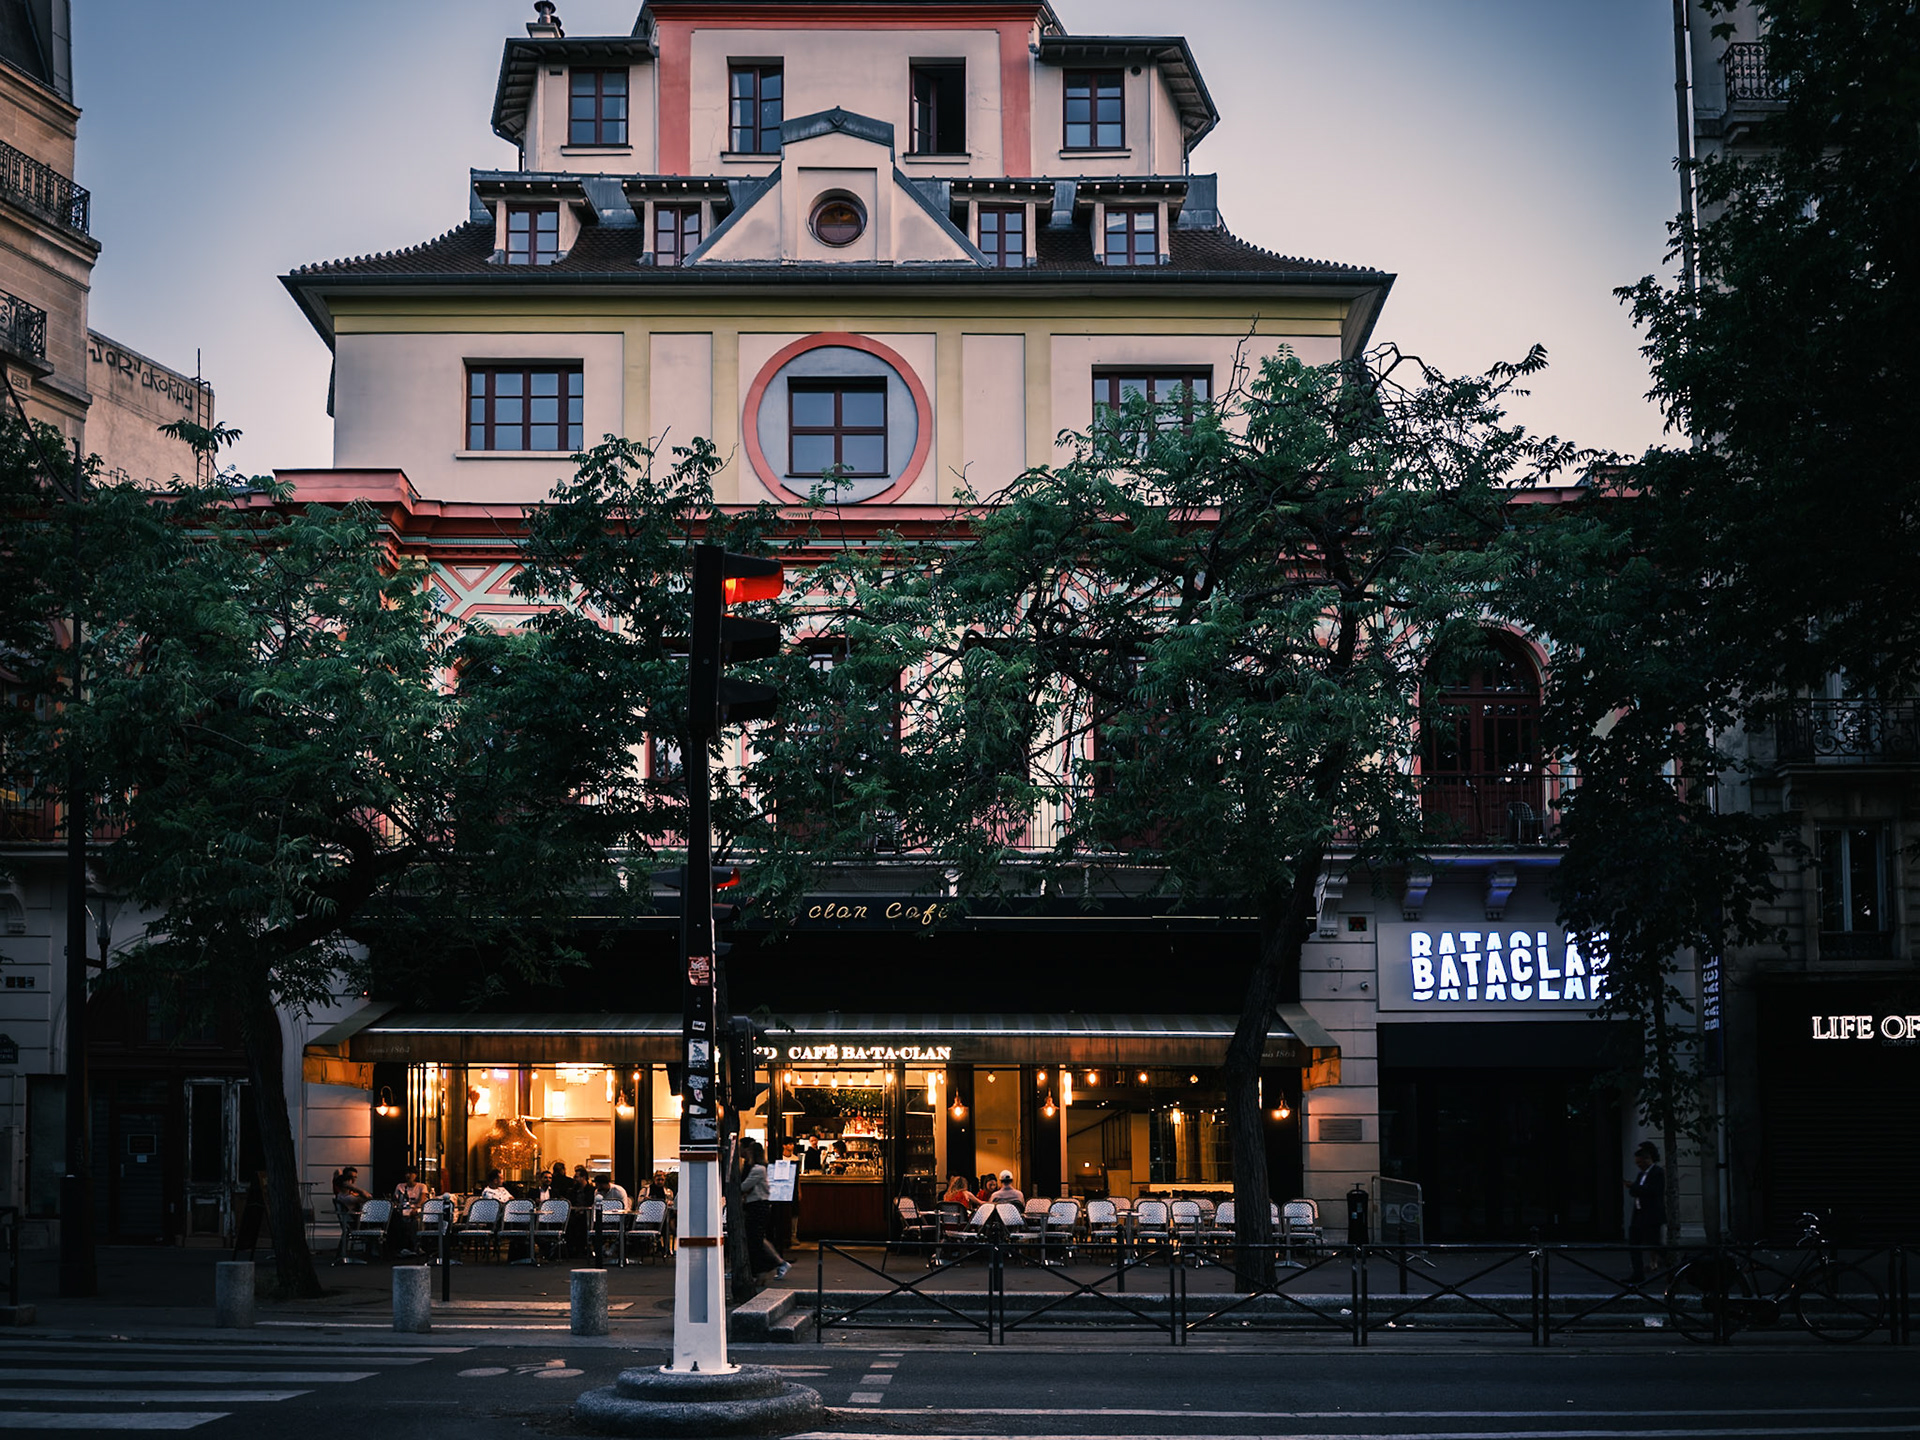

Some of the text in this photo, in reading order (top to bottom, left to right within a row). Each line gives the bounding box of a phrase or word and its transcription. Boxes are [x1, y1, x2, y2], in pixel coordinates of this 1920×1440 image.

[1811, 1015, 1920, 1039] LIFE OF
[788, 1044, 838, 1060] CAFÉ
